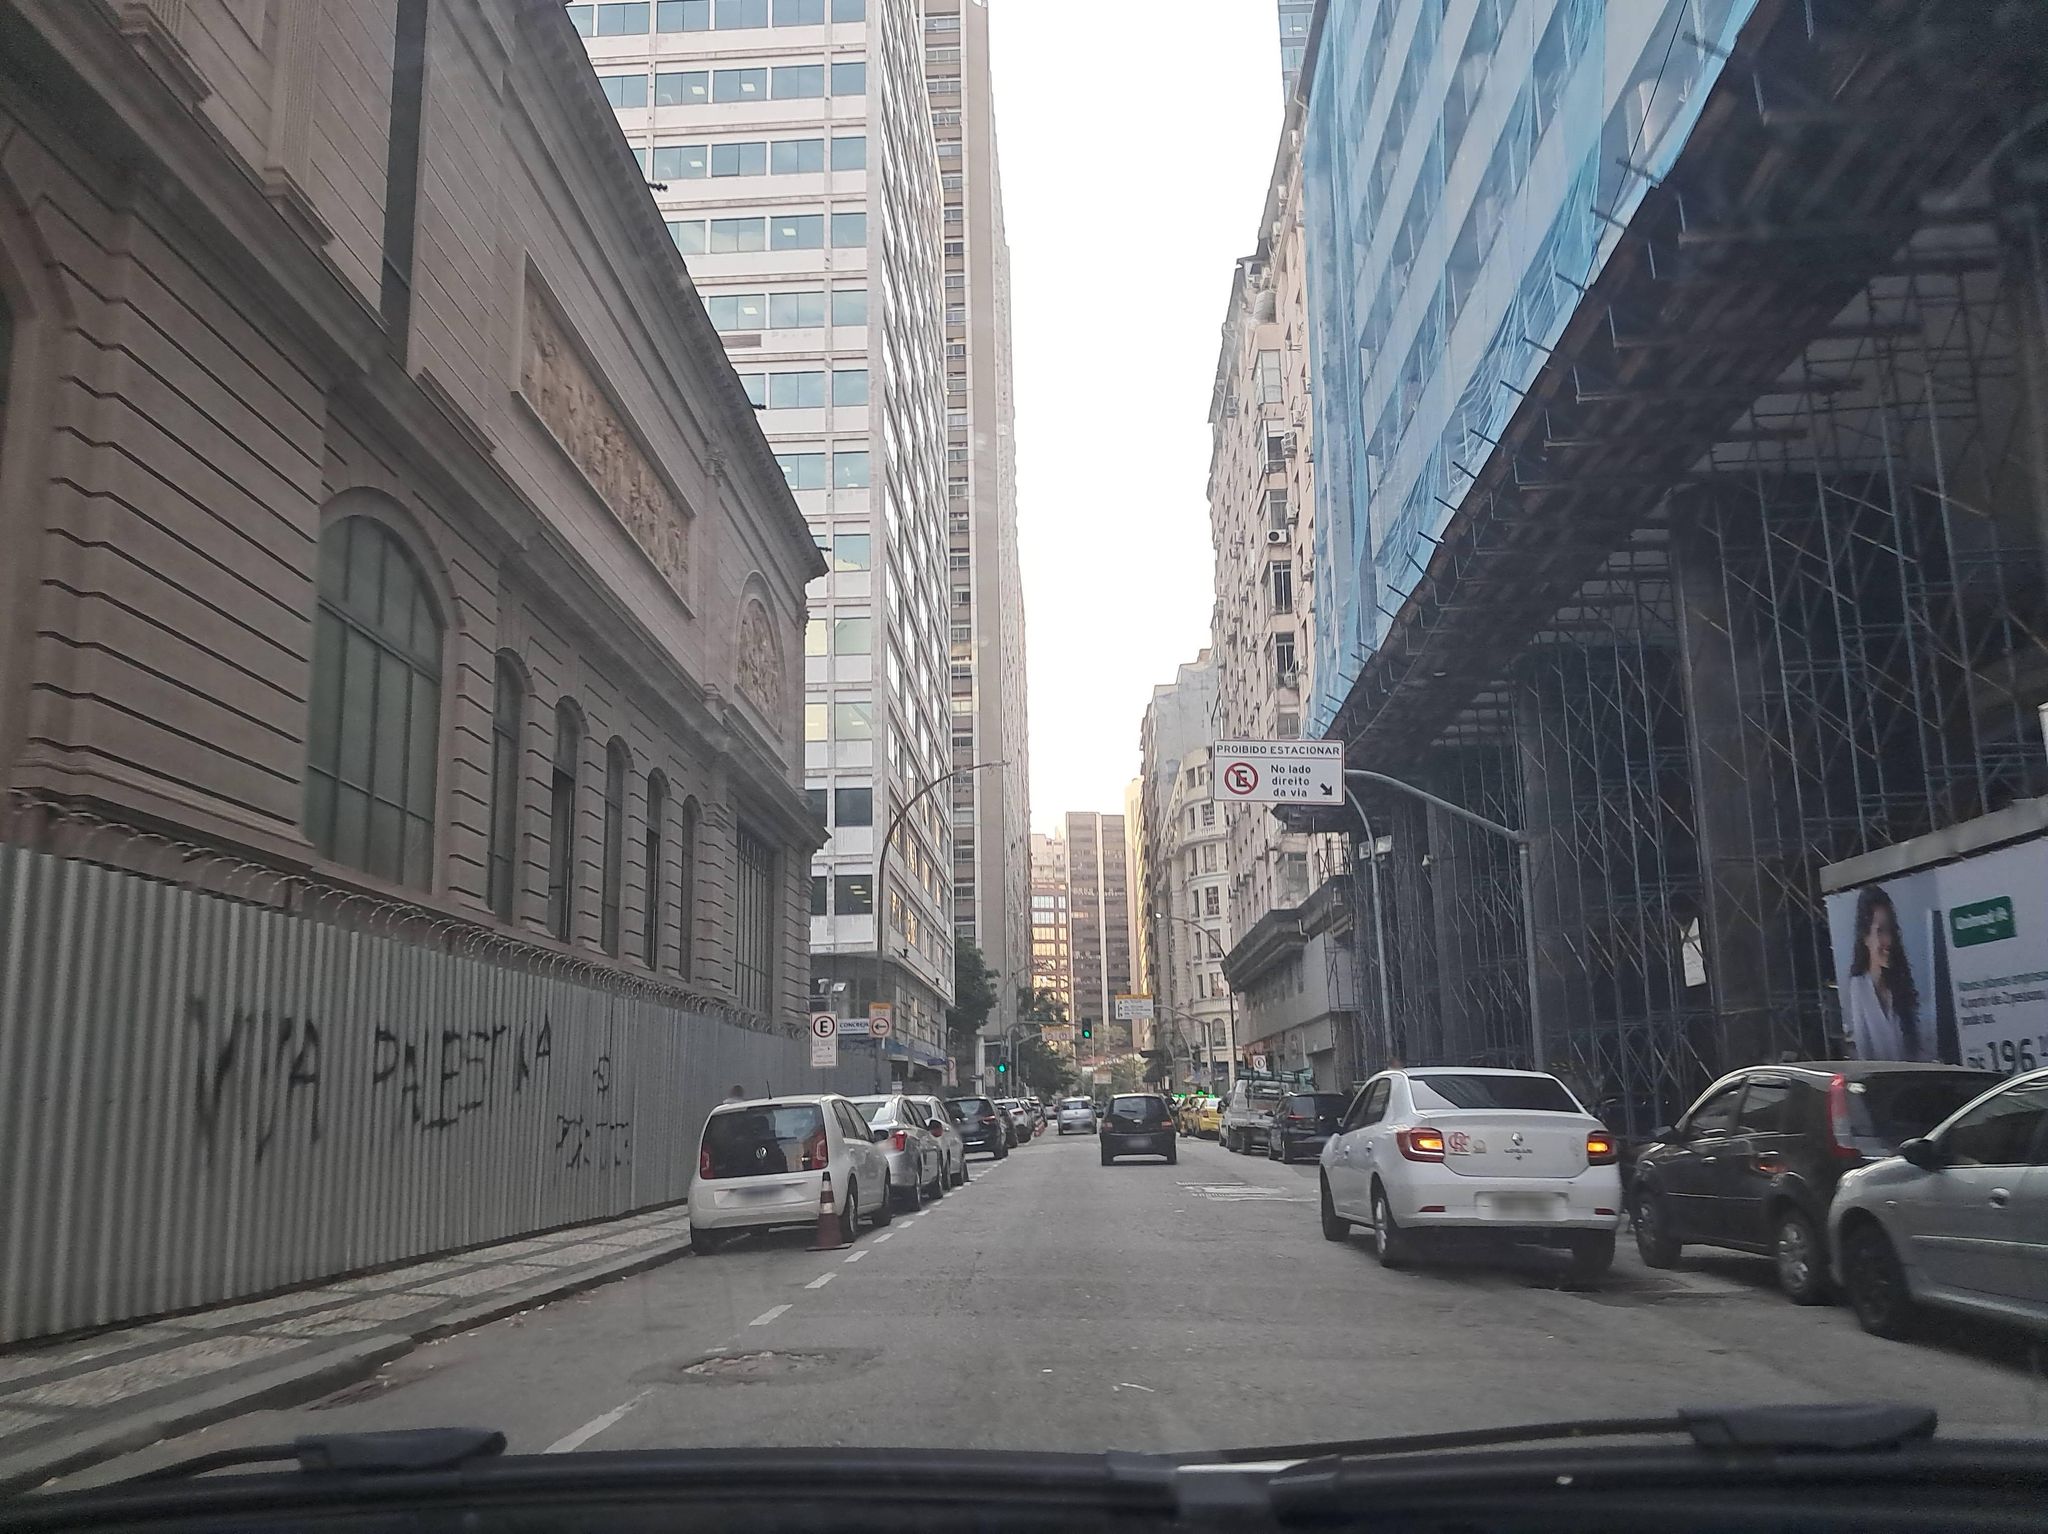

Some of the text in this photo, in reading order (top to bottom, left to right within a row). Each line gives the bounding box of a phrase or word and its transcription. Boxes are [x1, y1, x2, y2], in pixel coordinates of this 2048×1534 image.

[1216, 744, 1340, 755] PROIBIDO ESTACIONAR
[1270, 764, 1312, 774] No lado
[1271, 776, 1310, 786] direito
[1273, 788, 1308, 798] da via
[820, 1020, 828, 1033] E
